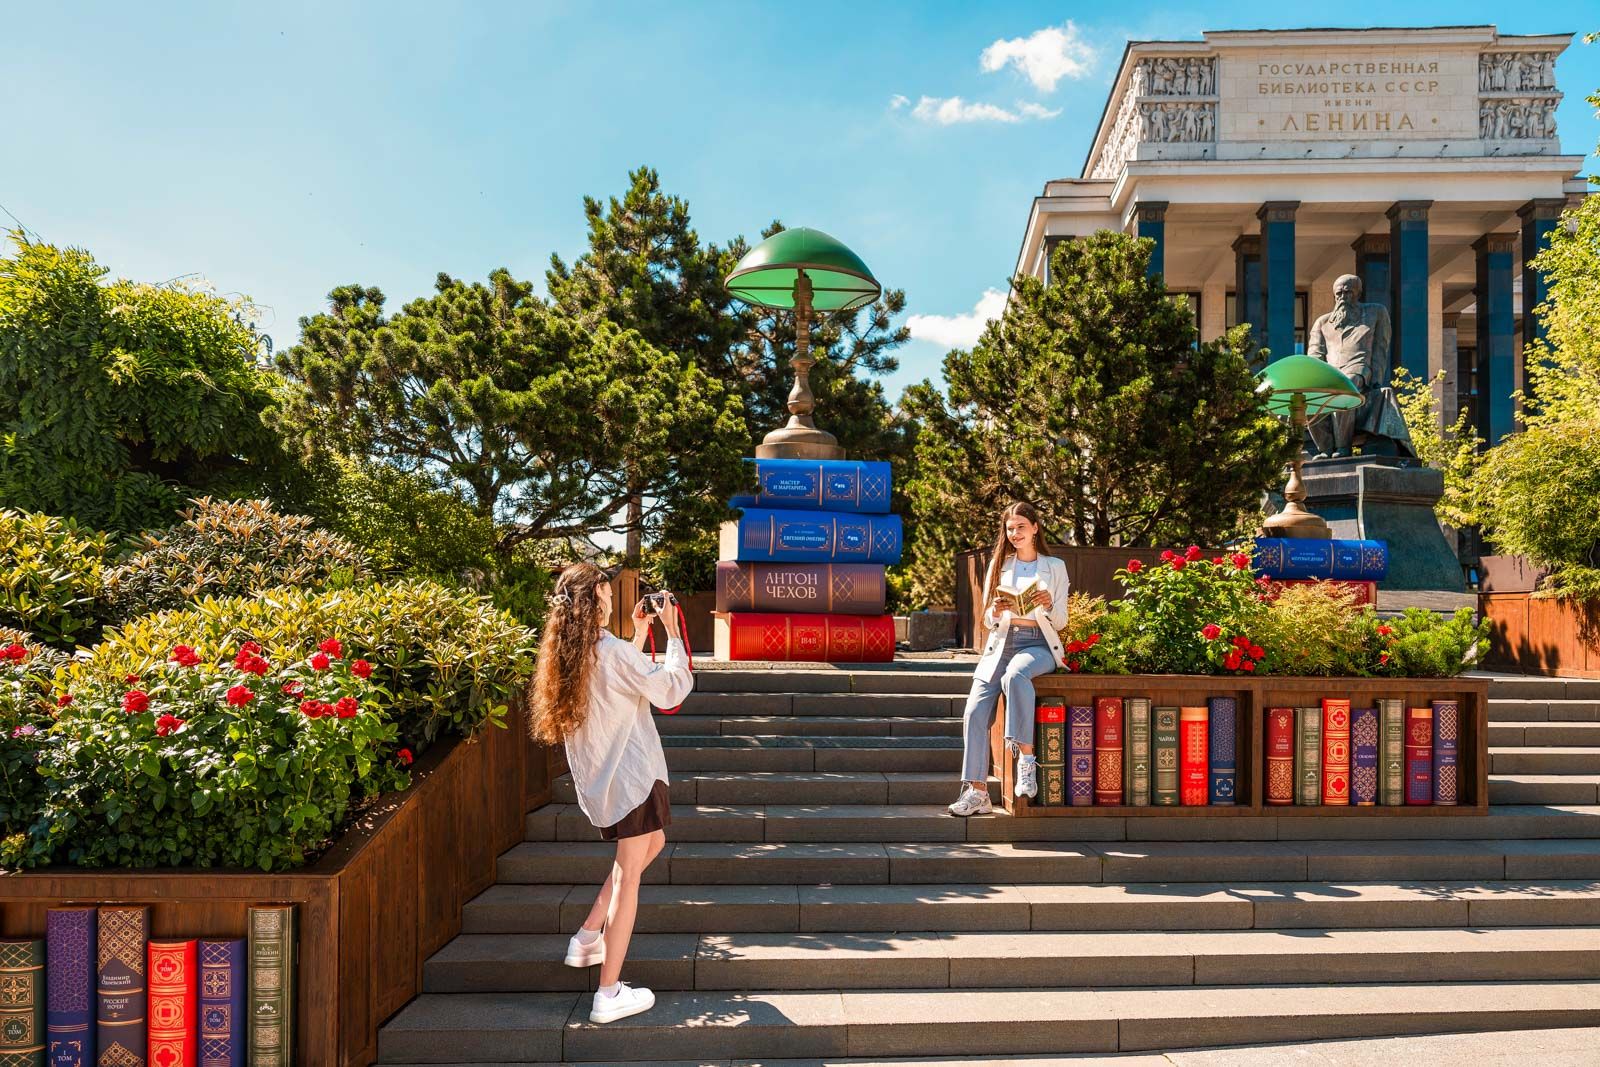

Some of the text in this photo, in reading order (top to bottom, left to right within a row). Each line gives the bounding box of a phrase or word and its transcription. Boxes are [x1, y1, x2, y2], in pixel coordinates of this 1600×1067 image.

[1258, 62, 1439, 76] ГОСУДАРСТВЕННАЯ
[1258, 81, 1439, 94] БИБЛИОТЕКА СССР
[1324, 99, 1372, 107] ИМЕНИ
[1282, 112, 1414, 131] ЛЕНИНА
[766, 572, 818, 584] АНТОН
[766, 586, 816, 598] ЧЕХОВ
